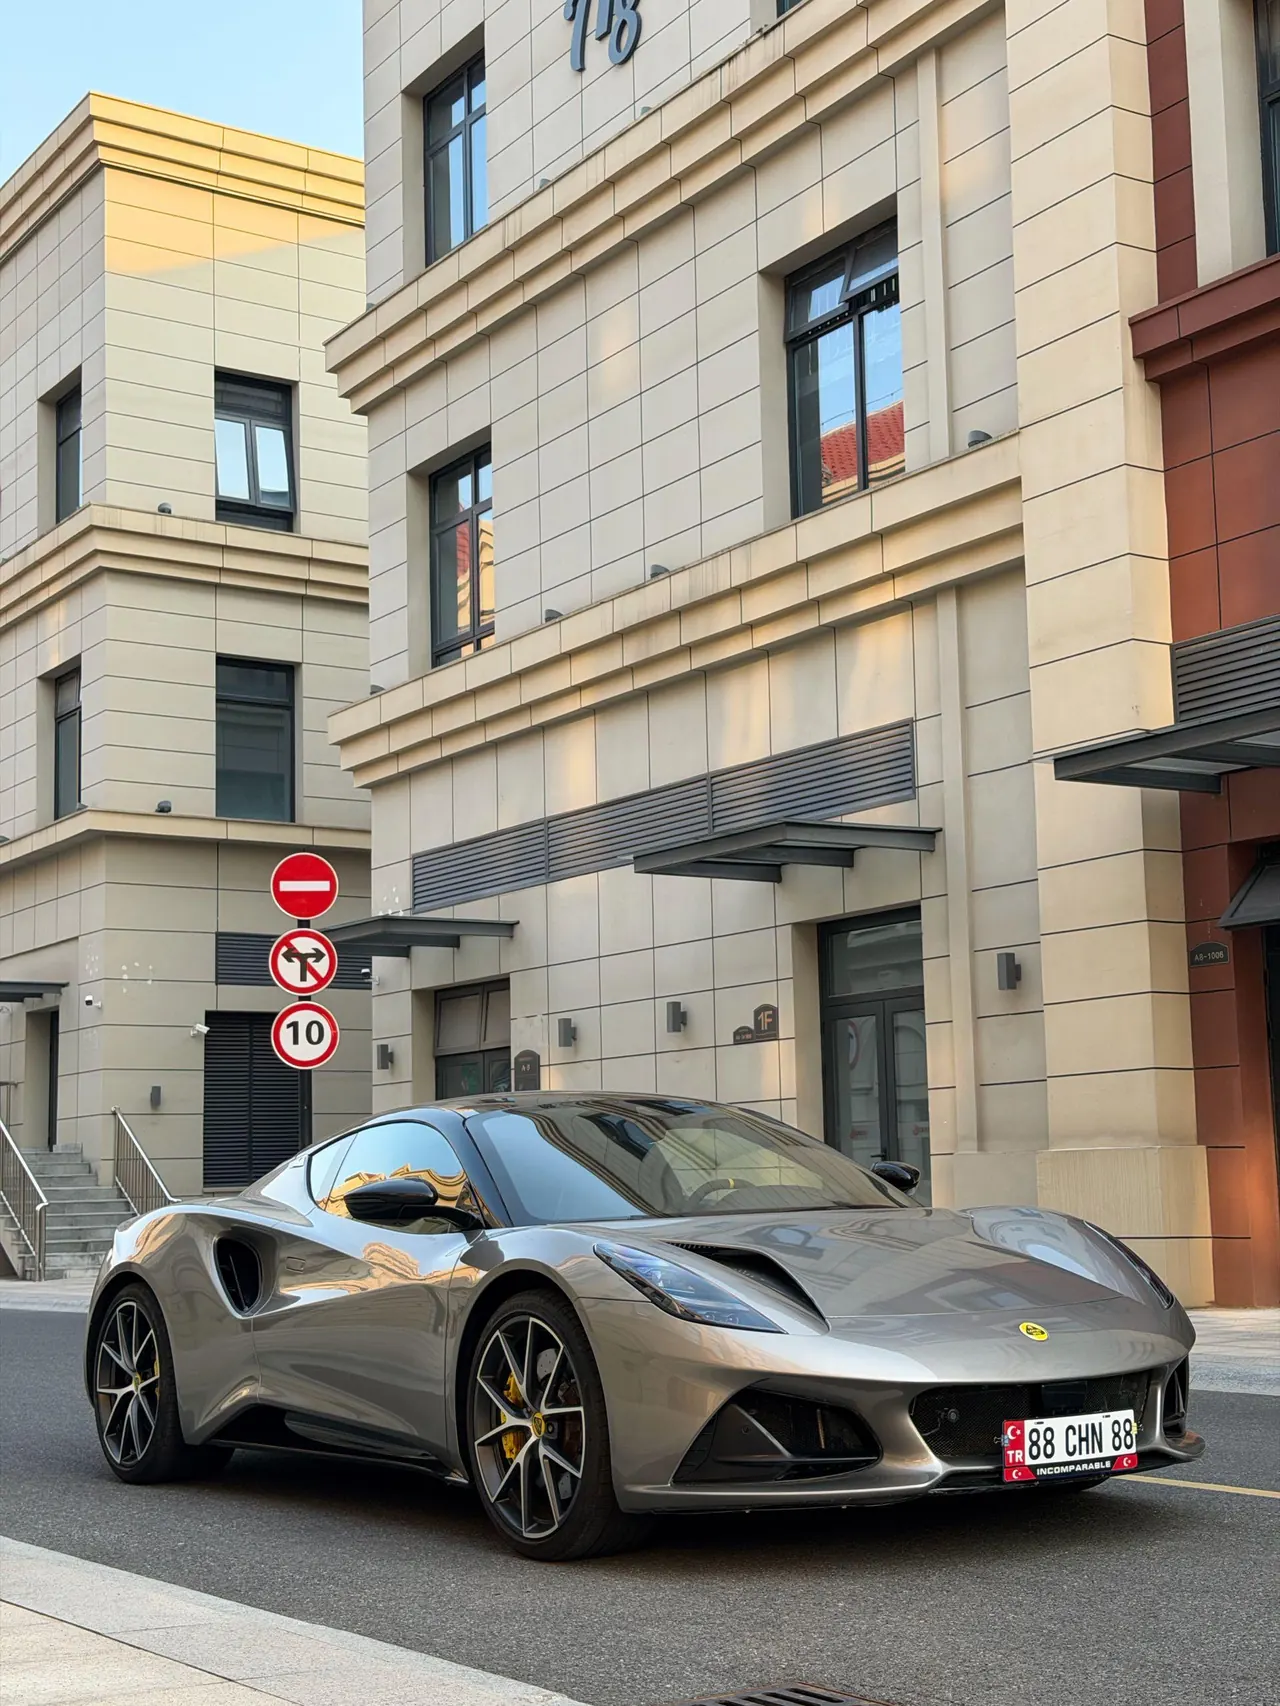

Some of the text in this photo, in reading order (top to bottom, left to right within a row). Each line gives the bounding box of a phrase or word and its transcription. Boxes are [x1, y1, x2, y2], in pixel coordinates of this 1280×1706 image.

[757, 1010, 773, 1031] 1F
[286, 1020, 325, 1046] 10
[1028, 1418, 1134, 1460] 88 CHN 88
[1007, 1450, 1023, 1464] TR
[1036, 1460, 1112, 1476] INCOMPARABLE
